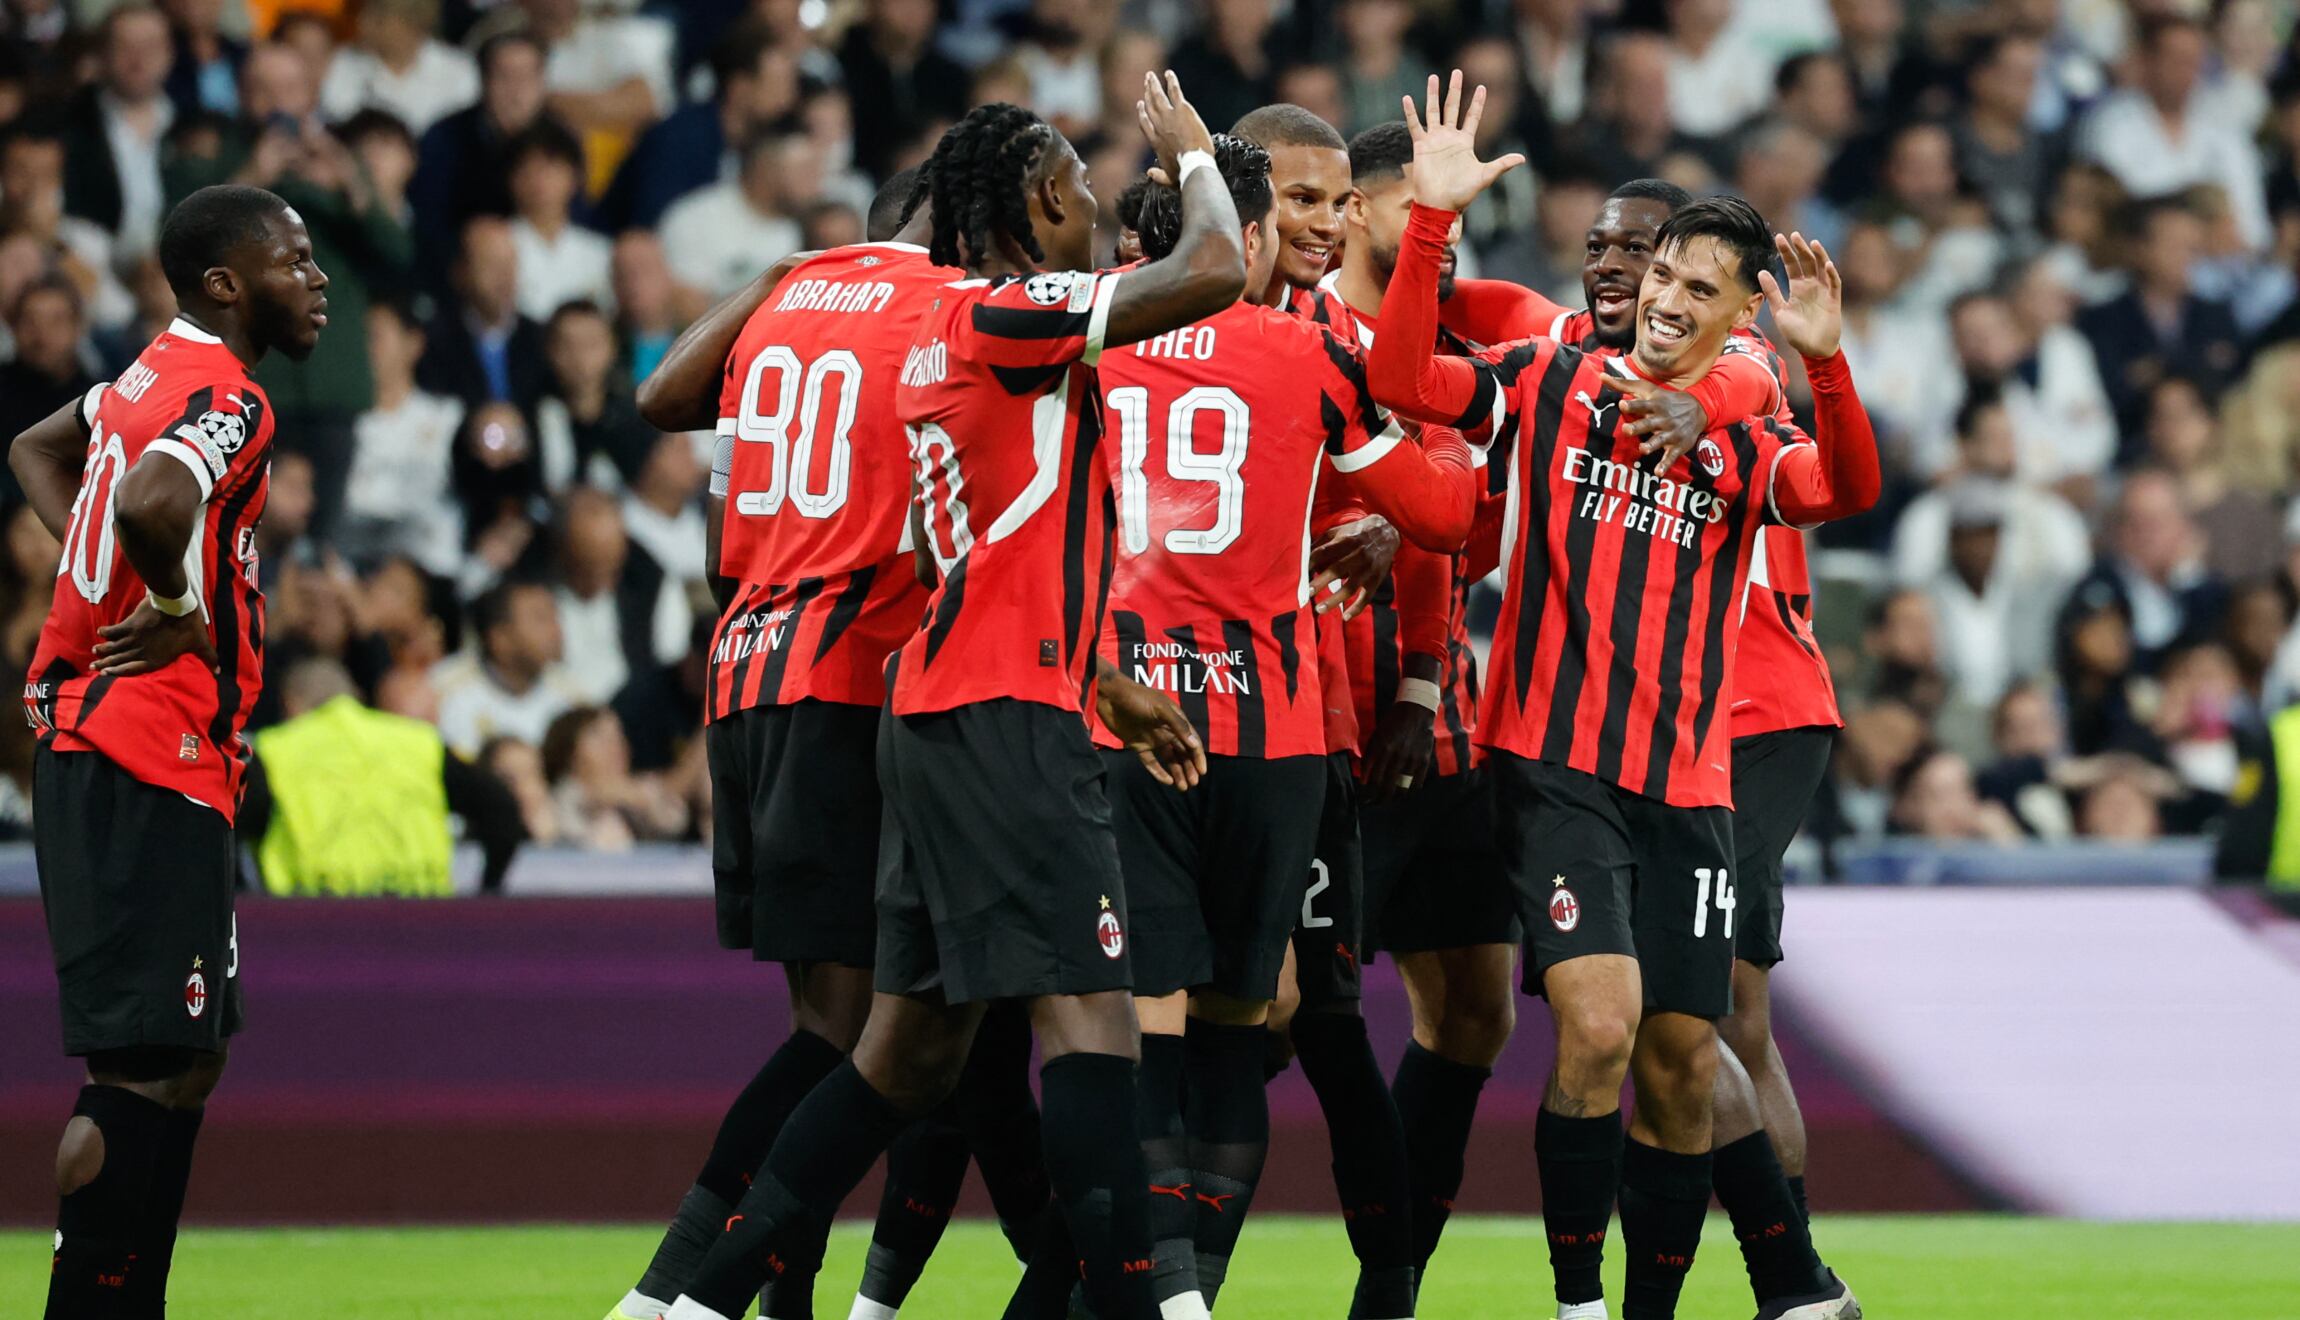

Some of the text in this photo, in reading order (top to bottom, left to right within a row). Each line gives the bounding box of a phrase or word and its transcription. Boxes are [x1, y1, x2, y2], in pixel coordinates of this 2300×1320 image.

[773, 279, 895, 312] ABRAHAM
[736, 345, 863, 519] 90
[1107, 386, 1250, 555] 19
[1562, 445, 1728, 524] Emirates
[1579, 491, 1696, 550] FLY BETTER
[713, 625, 786, 664] MILAN
[1134, 664, 1251, 695] MILAN
[1694, 868, 1736, 939] 14
